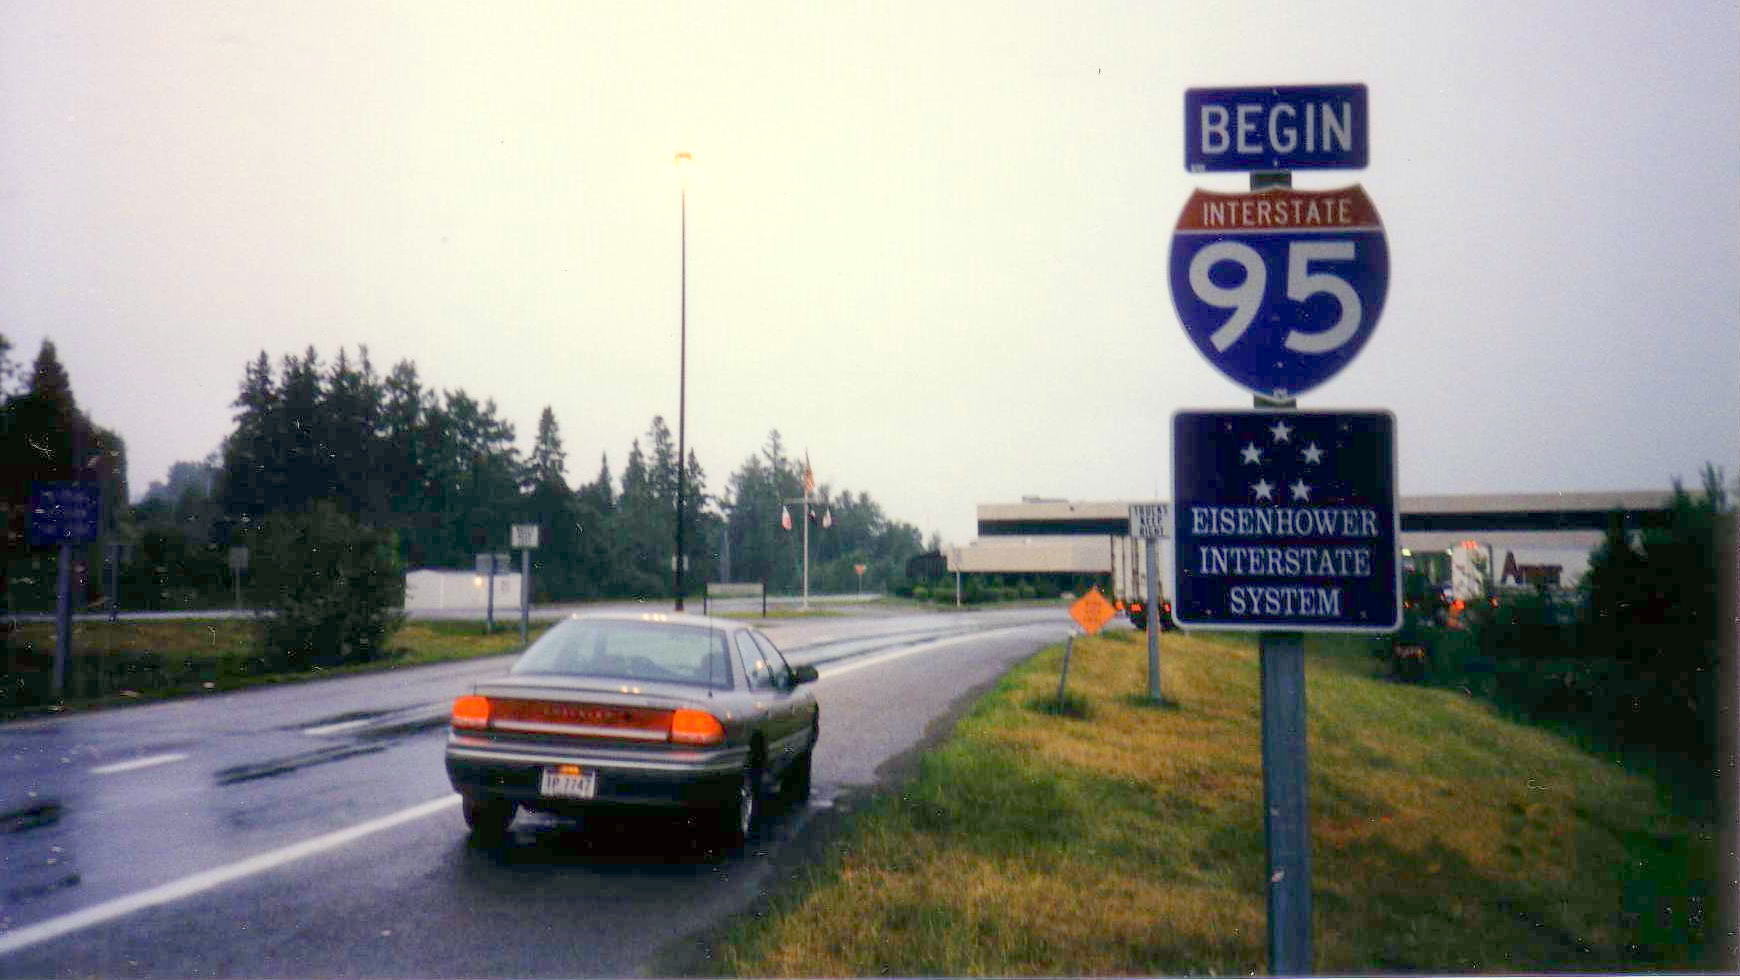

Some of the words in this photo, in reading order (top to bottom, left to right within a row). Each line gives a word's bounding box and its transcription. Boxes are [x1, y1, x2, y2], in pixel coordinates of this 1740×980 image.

[1200, 101, 1353, 155] BEGIN
[1202, 199, 1352, 226] INTERSTATE
[1188, 240, 1363, 355] 95
[1191, 506, 1379, 537] EISENHOWER
[1199, 545, 1371, 577] INTERSTATE
[1230, 585, 1342, 616] SYSTEM
